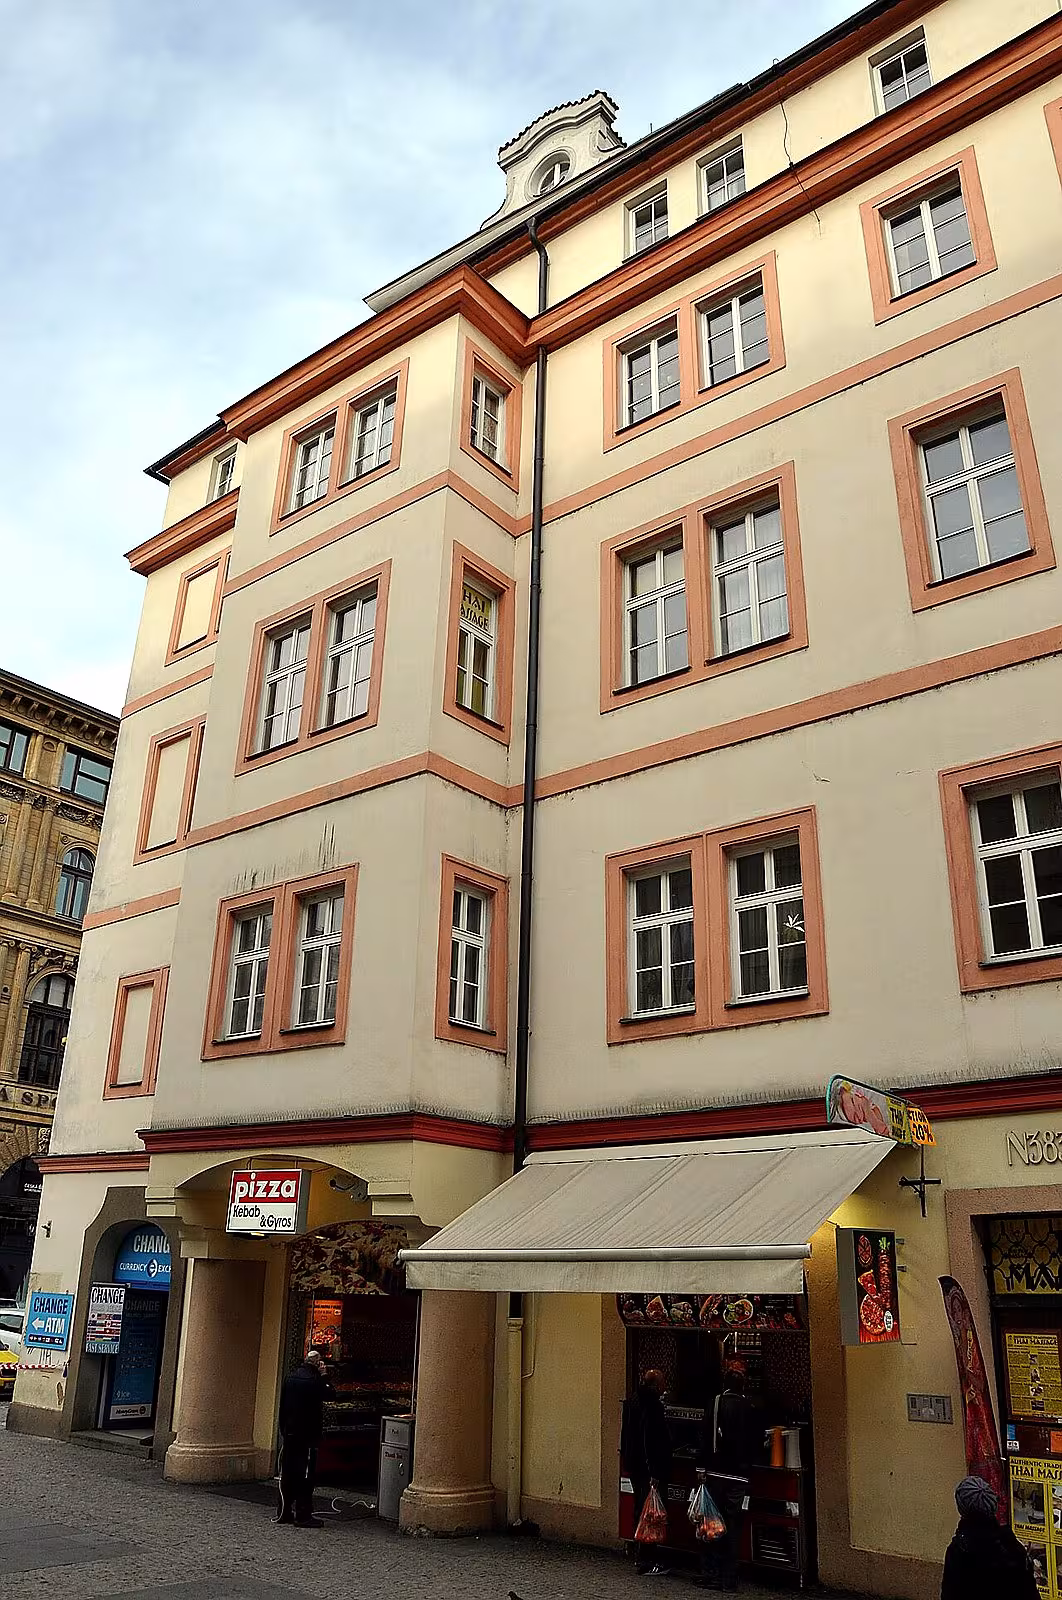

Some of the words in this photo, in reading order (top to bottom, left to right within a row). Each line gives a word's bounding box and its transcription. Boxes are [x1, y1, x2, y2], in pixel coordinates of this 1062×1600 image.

[234, 1172, 296, 1204] pizza
[233, 1204, 260, 1217] Kebab
[260, 1214, 292, 1231] &Gyros
[133, 1234, 170, 1253] CHANG
[119, 1262, 147, 1271] CURRENCY
[91, 1287, 125, 1304] CHANGE
[33, 1296, 69, 1314] CHANGE
[44, 1317, 66, 1334] ATM
[86, 1343, 98, 1353] FAST
[97, 1343, 119, 1354] SERVICE
[1010, 1459, 1042, 1467] AUTHENTIC
[1010, 1465, 1034, 1477] THAI
